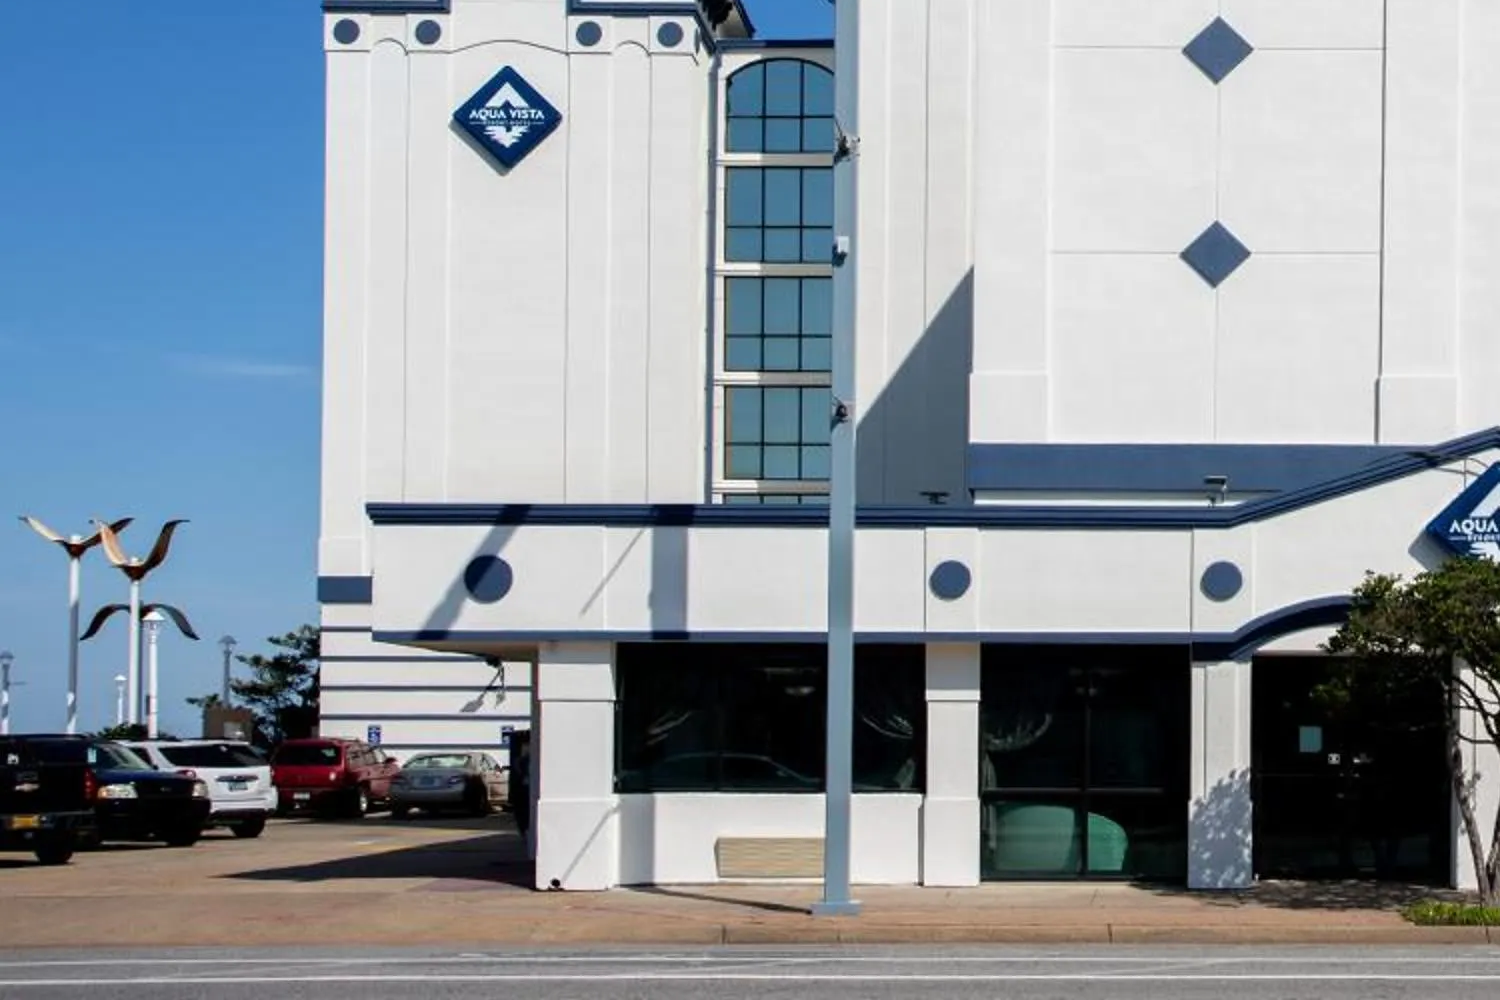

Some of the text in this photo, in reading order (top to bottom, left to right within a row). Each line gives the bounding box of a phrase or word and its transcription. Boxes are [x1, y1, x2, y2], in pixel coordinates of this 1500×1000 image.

[469, 109, 545, 120] AQUA VISTA
[1449, 519, 1499, 534] AQUA
